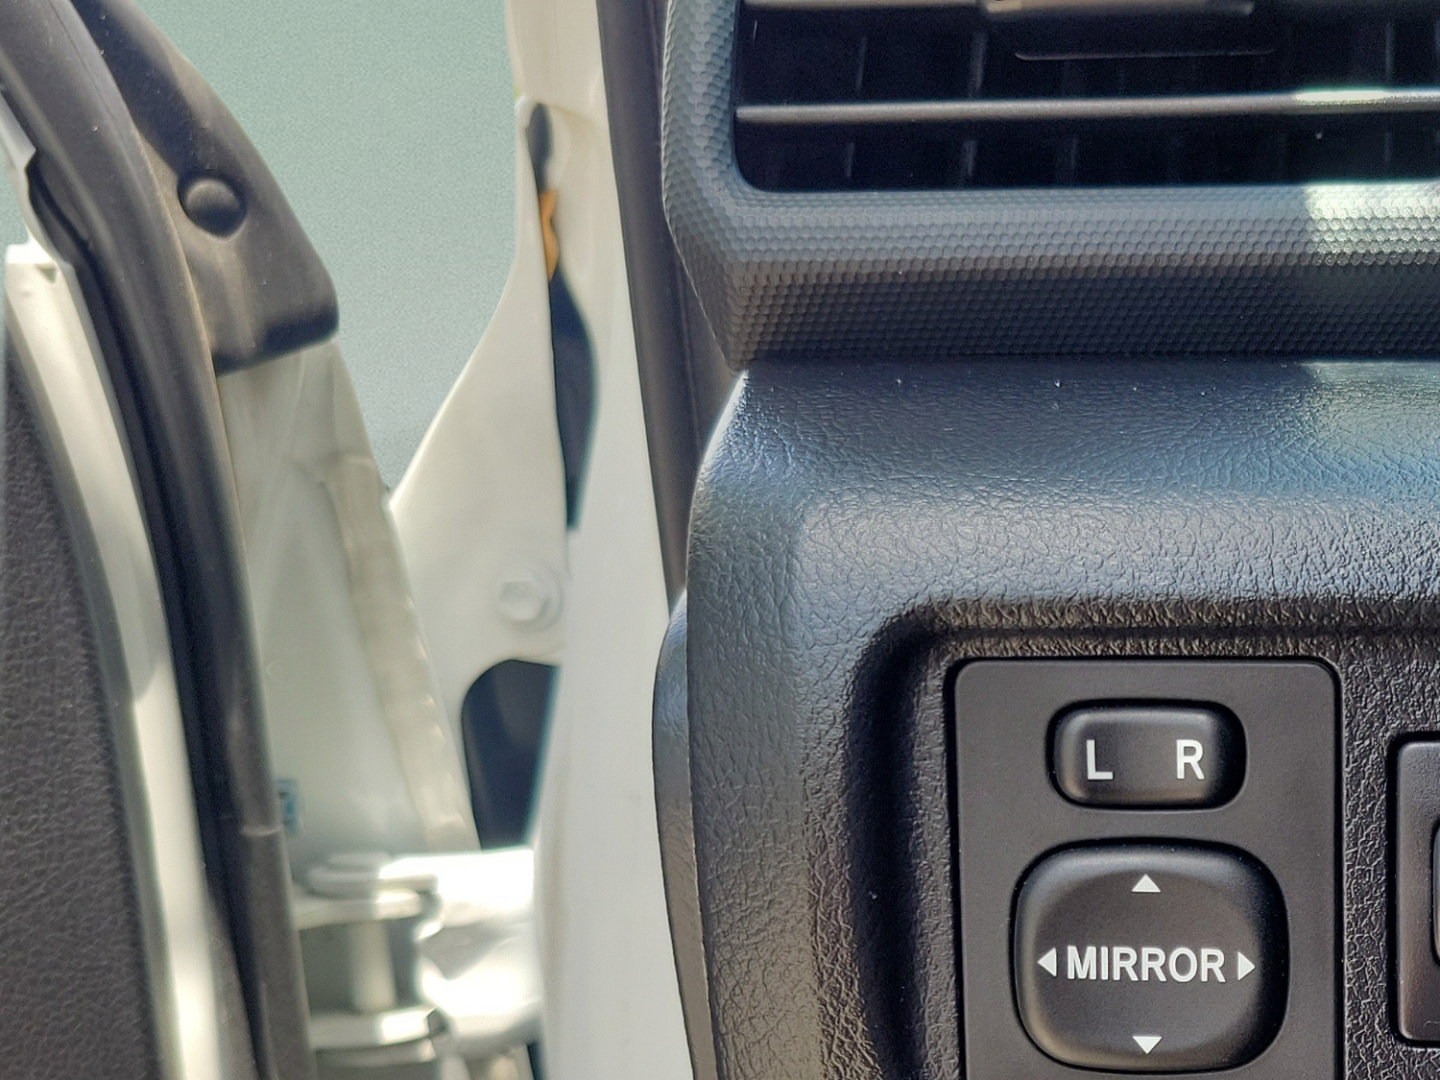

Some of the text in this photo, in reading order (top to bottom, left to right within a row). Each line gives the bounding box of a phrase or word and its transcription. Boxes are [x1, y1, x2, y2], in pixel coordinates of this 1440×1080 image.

[1086, 739, 1206, 780] L R
[1067, 945, 1227, 983] MIRROR
